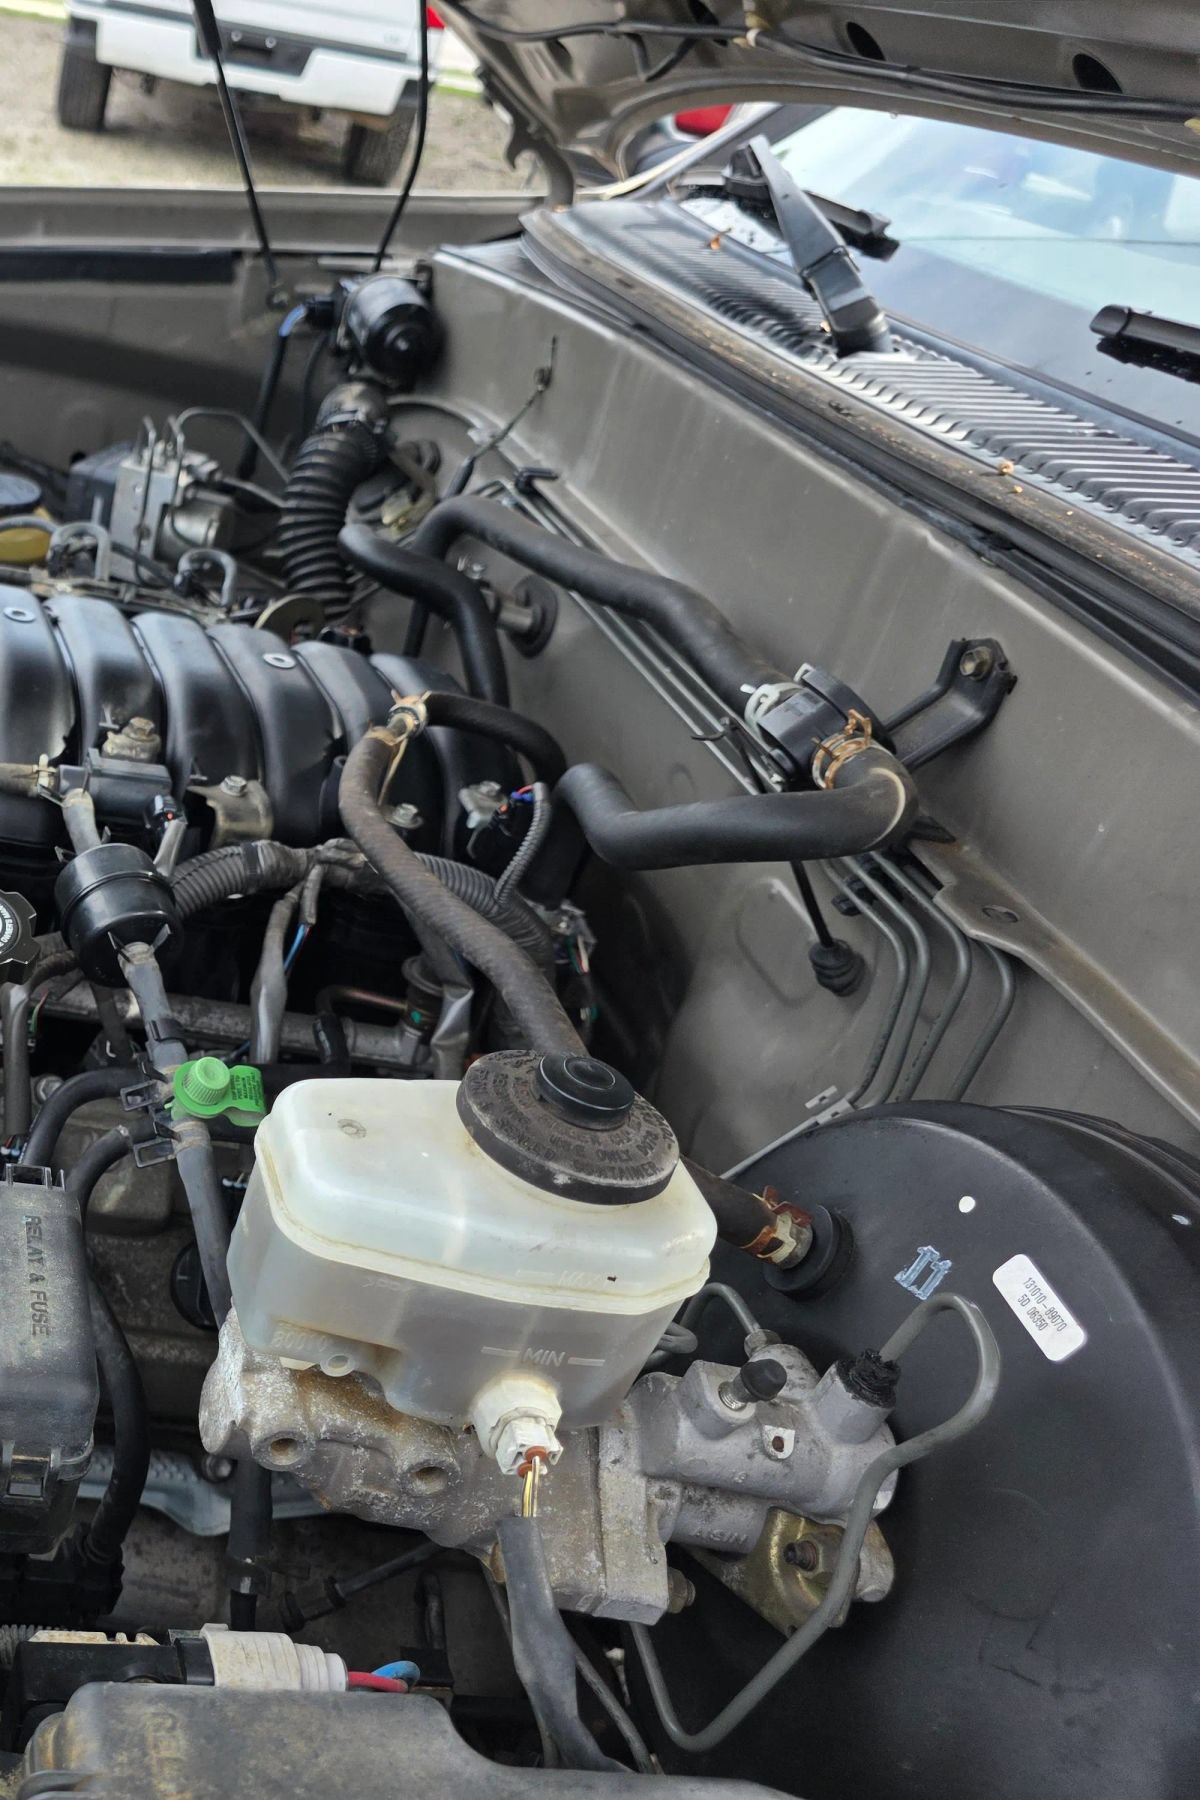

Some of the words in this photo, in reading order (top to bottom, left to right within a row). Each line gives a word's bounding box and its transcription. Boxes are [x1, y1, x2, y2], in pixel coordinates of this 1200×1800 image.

[23, 1215, 44, 1267] RELAY
[29, 1272, 45, 1285] &
[29, 1289, 50, 1338] FUSE
[522, 1346, 566, 1367] MIN
